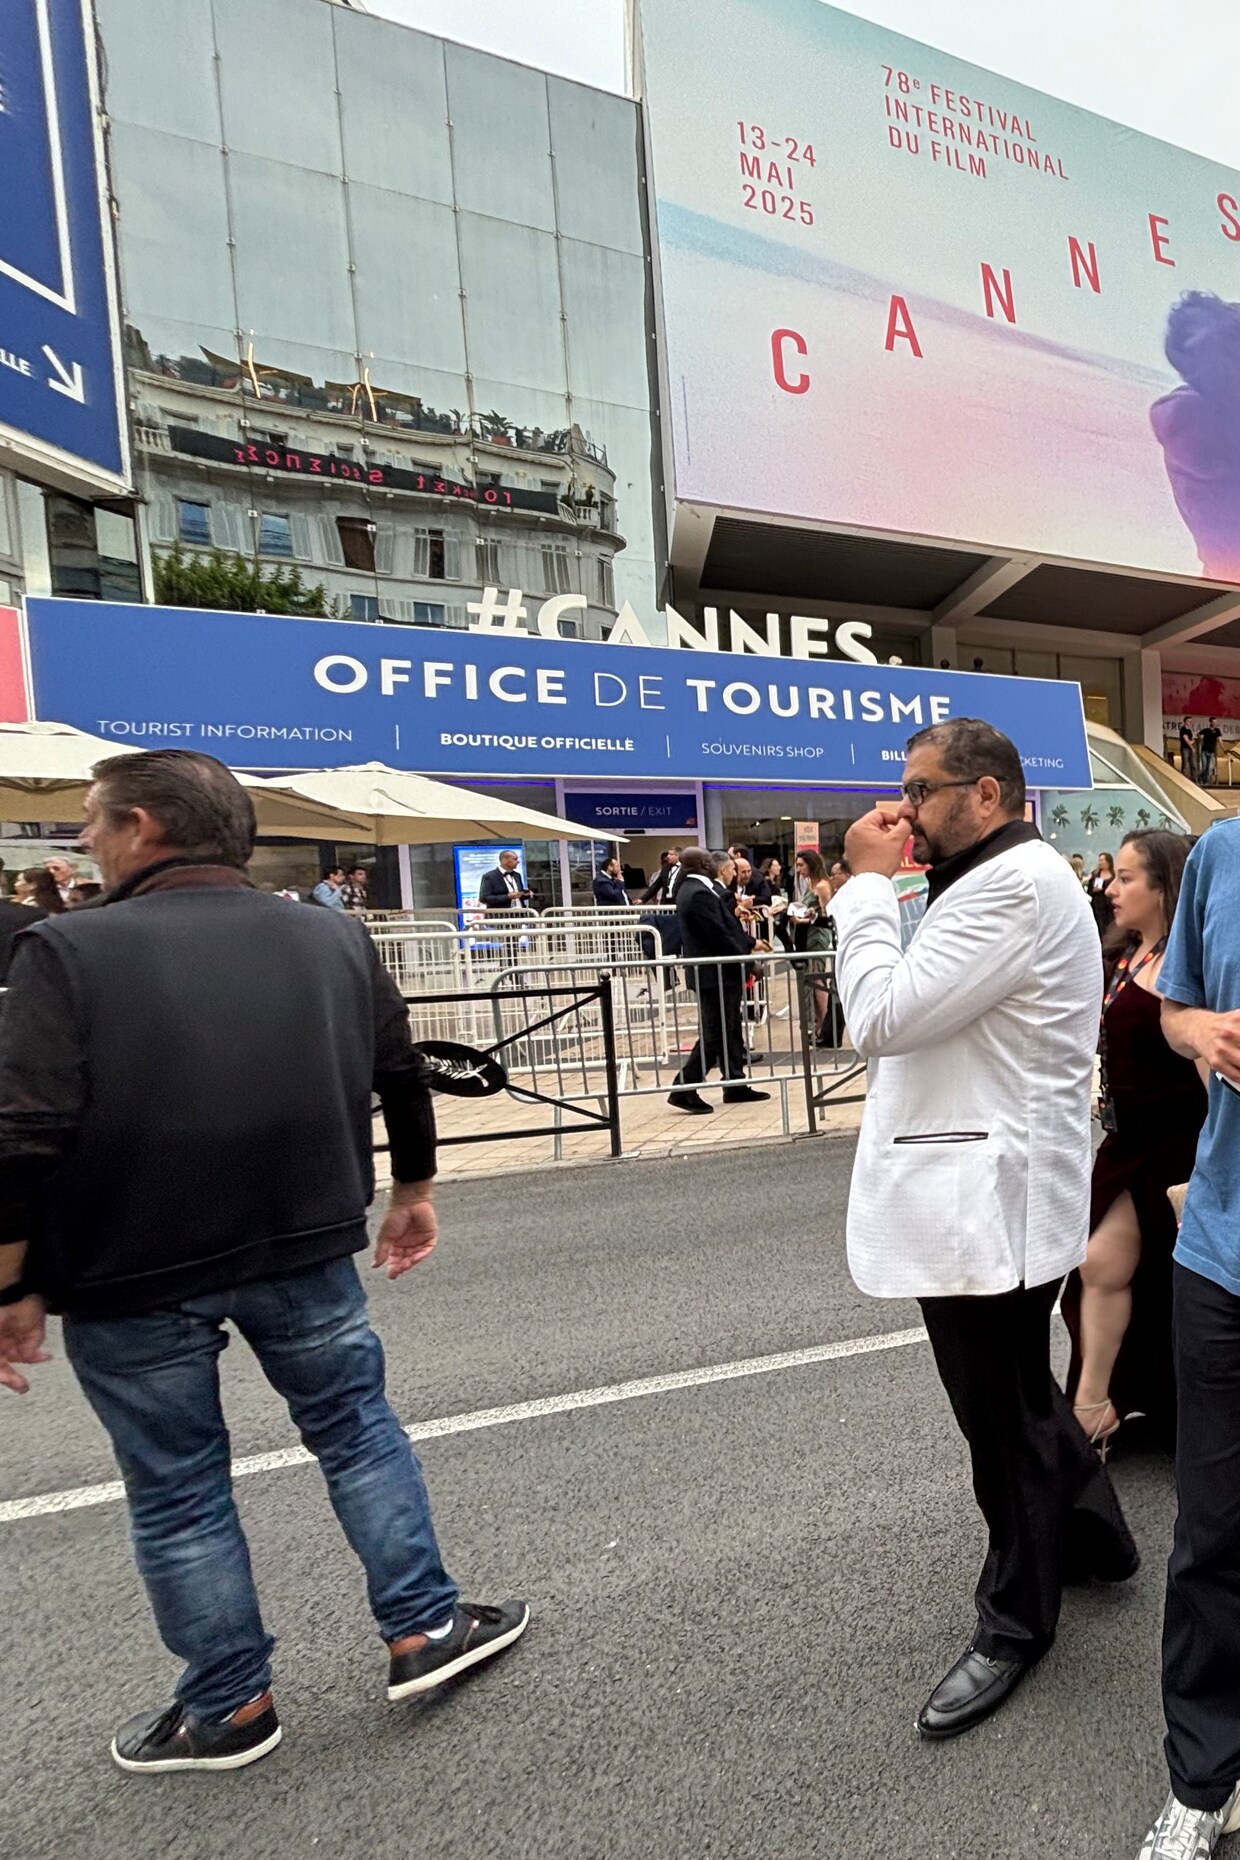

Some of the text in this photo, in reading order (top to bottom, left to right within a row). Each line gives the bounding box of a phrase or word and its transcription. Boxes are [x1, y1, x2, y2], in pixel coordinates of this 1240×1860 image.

[930, 84, 1037, 142] FESTIVAL
[737, 120, 817, 167] 13-24
[884, 94, 1069, 180] INTERNATIONAL
[888, 125, 987, 179] DU FILM
[740, 152, 794, 190] MAI
[742, 184, 814, 226] 2025
[314, 654, 950, 725] OFFICE DE TOURISME
[97, 720, 353, 742] TOURIST INFORMATION
[440, 733, 635, 752] BOUTIQUE OFFICIELLE
[701, 740, 824, 759] SOUVENIRS SHOP
[595, 806, 639, 816] SORTIE
[648, 806, 673, 816] EXIT
